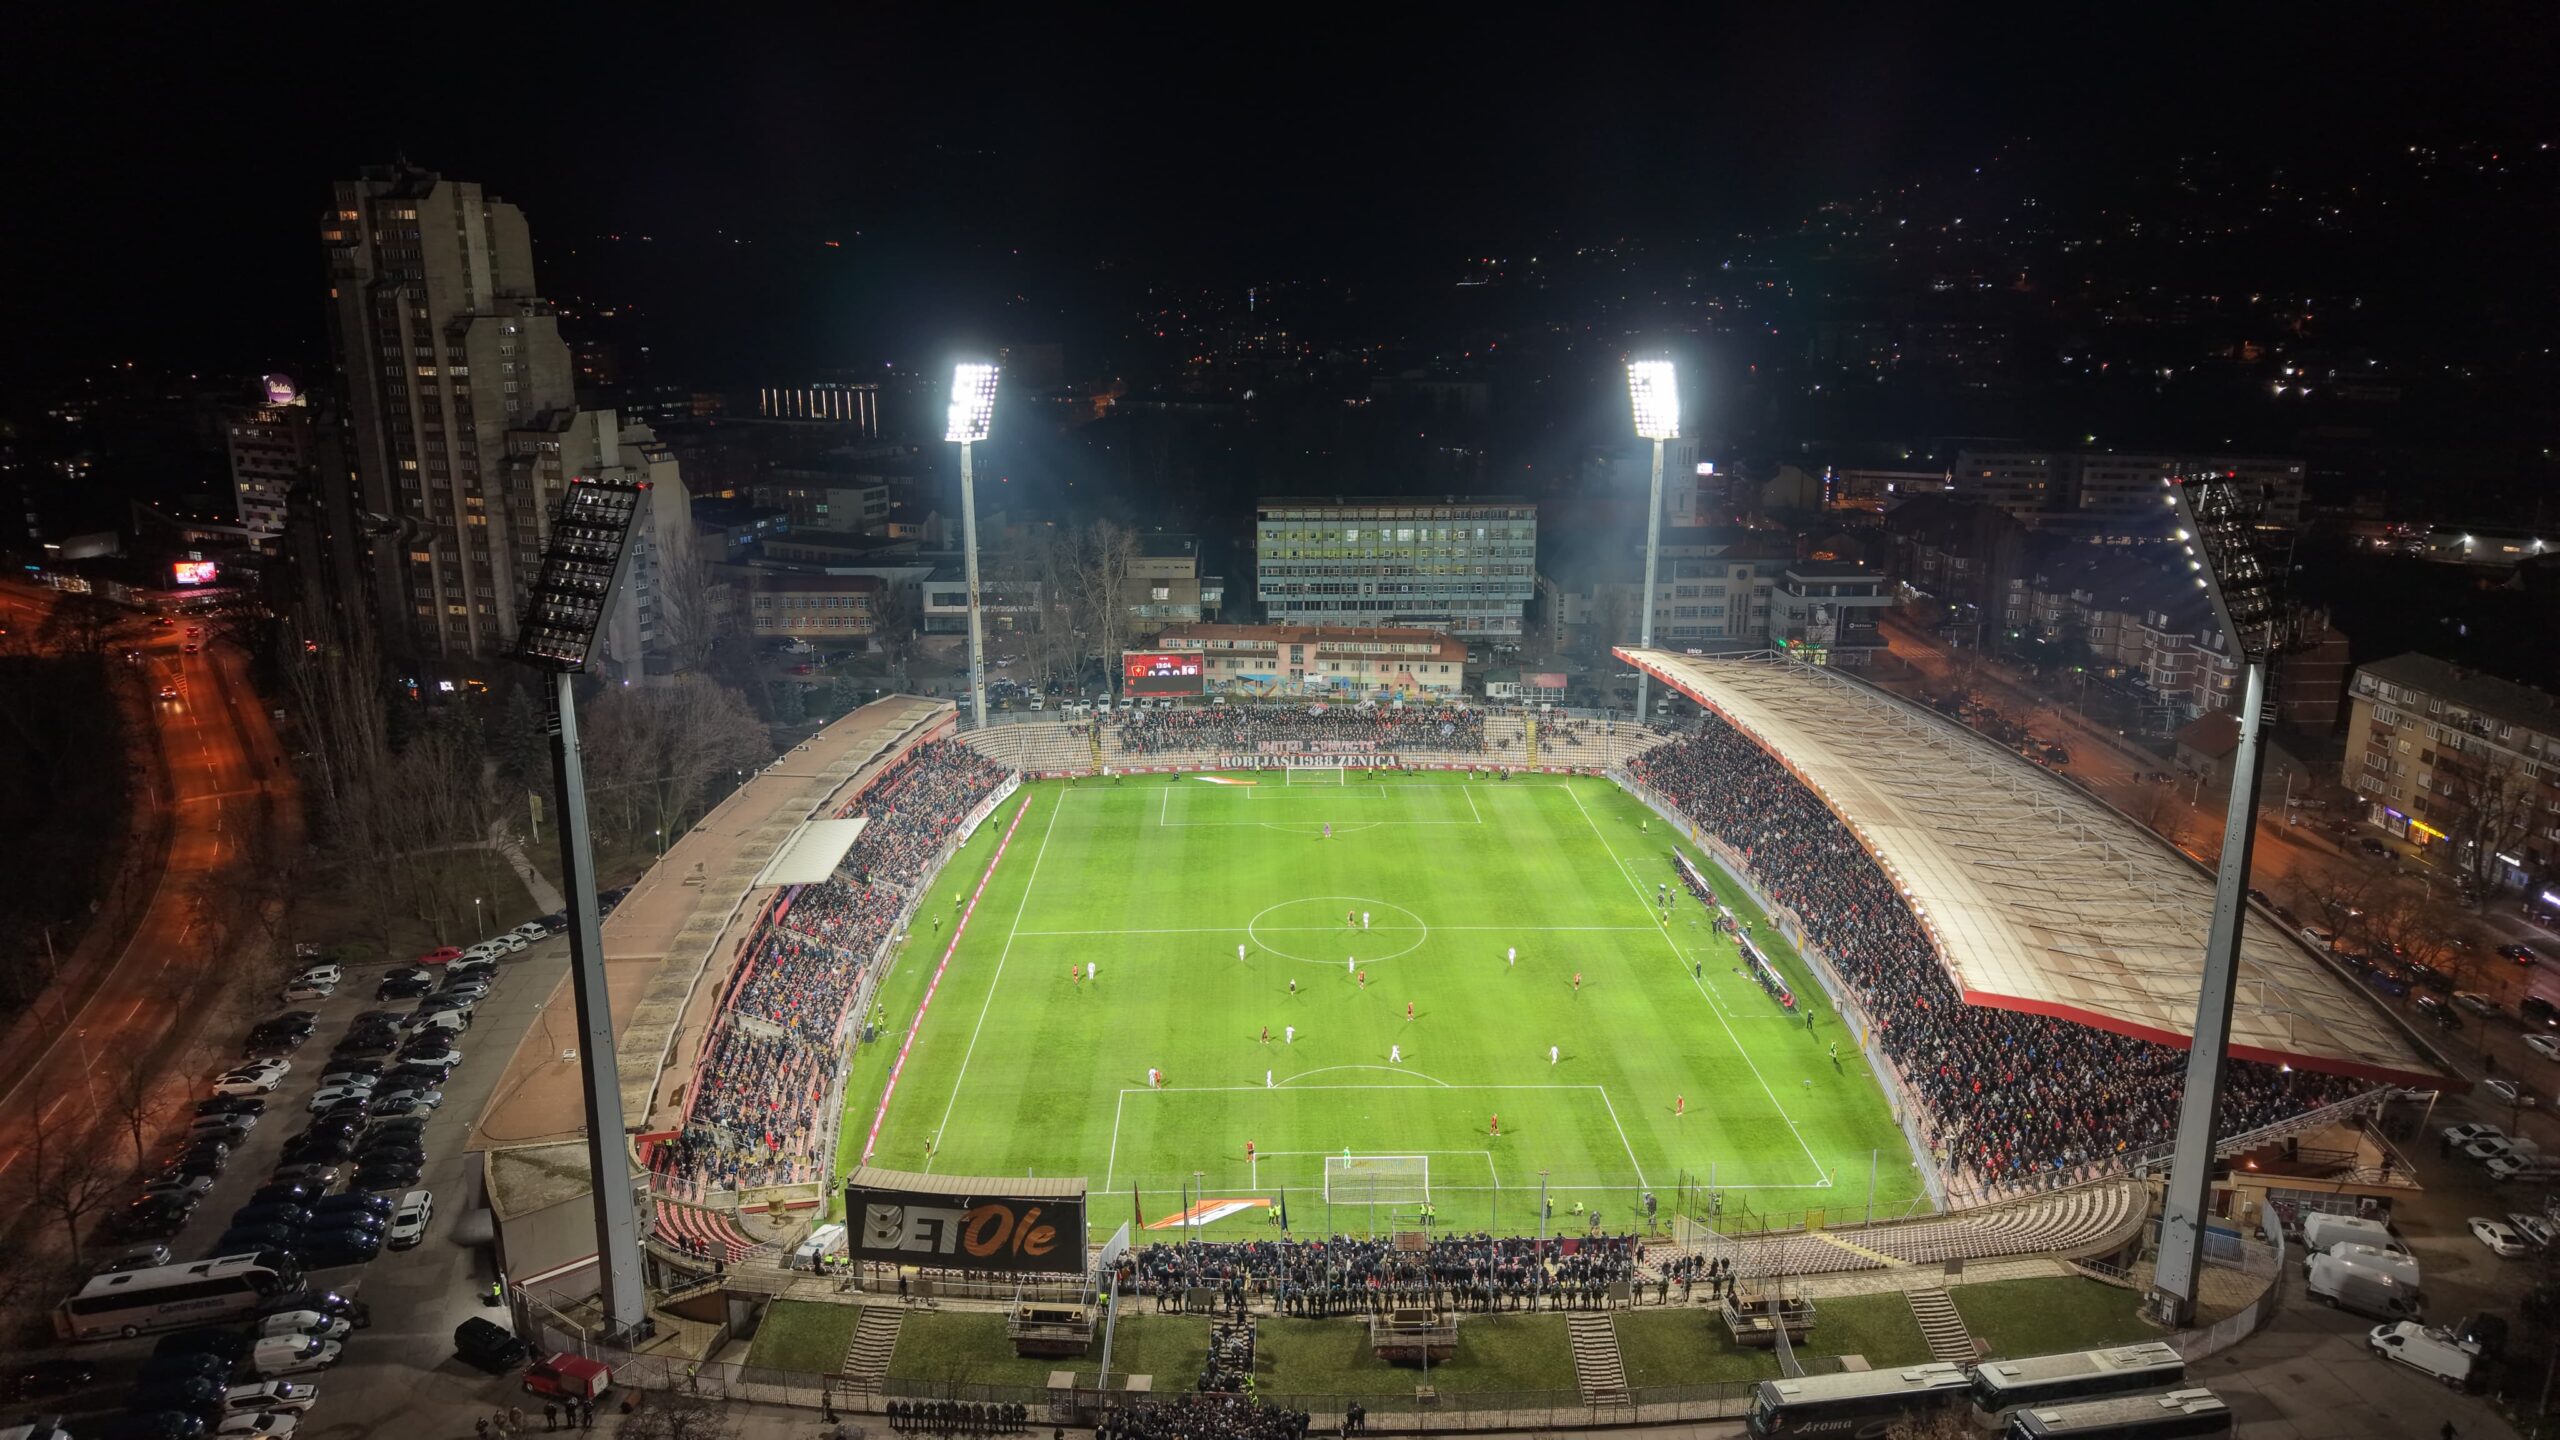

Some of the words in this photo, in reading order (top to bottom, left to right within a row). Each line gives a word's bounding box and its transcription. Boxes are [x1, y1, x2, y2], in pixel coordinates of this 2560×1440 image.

[1299, 755, 1334, 767] 1988
[1337, 755, 1397, 767] ZENICA
[1793, 1420, 1853, 1434] Aroma
